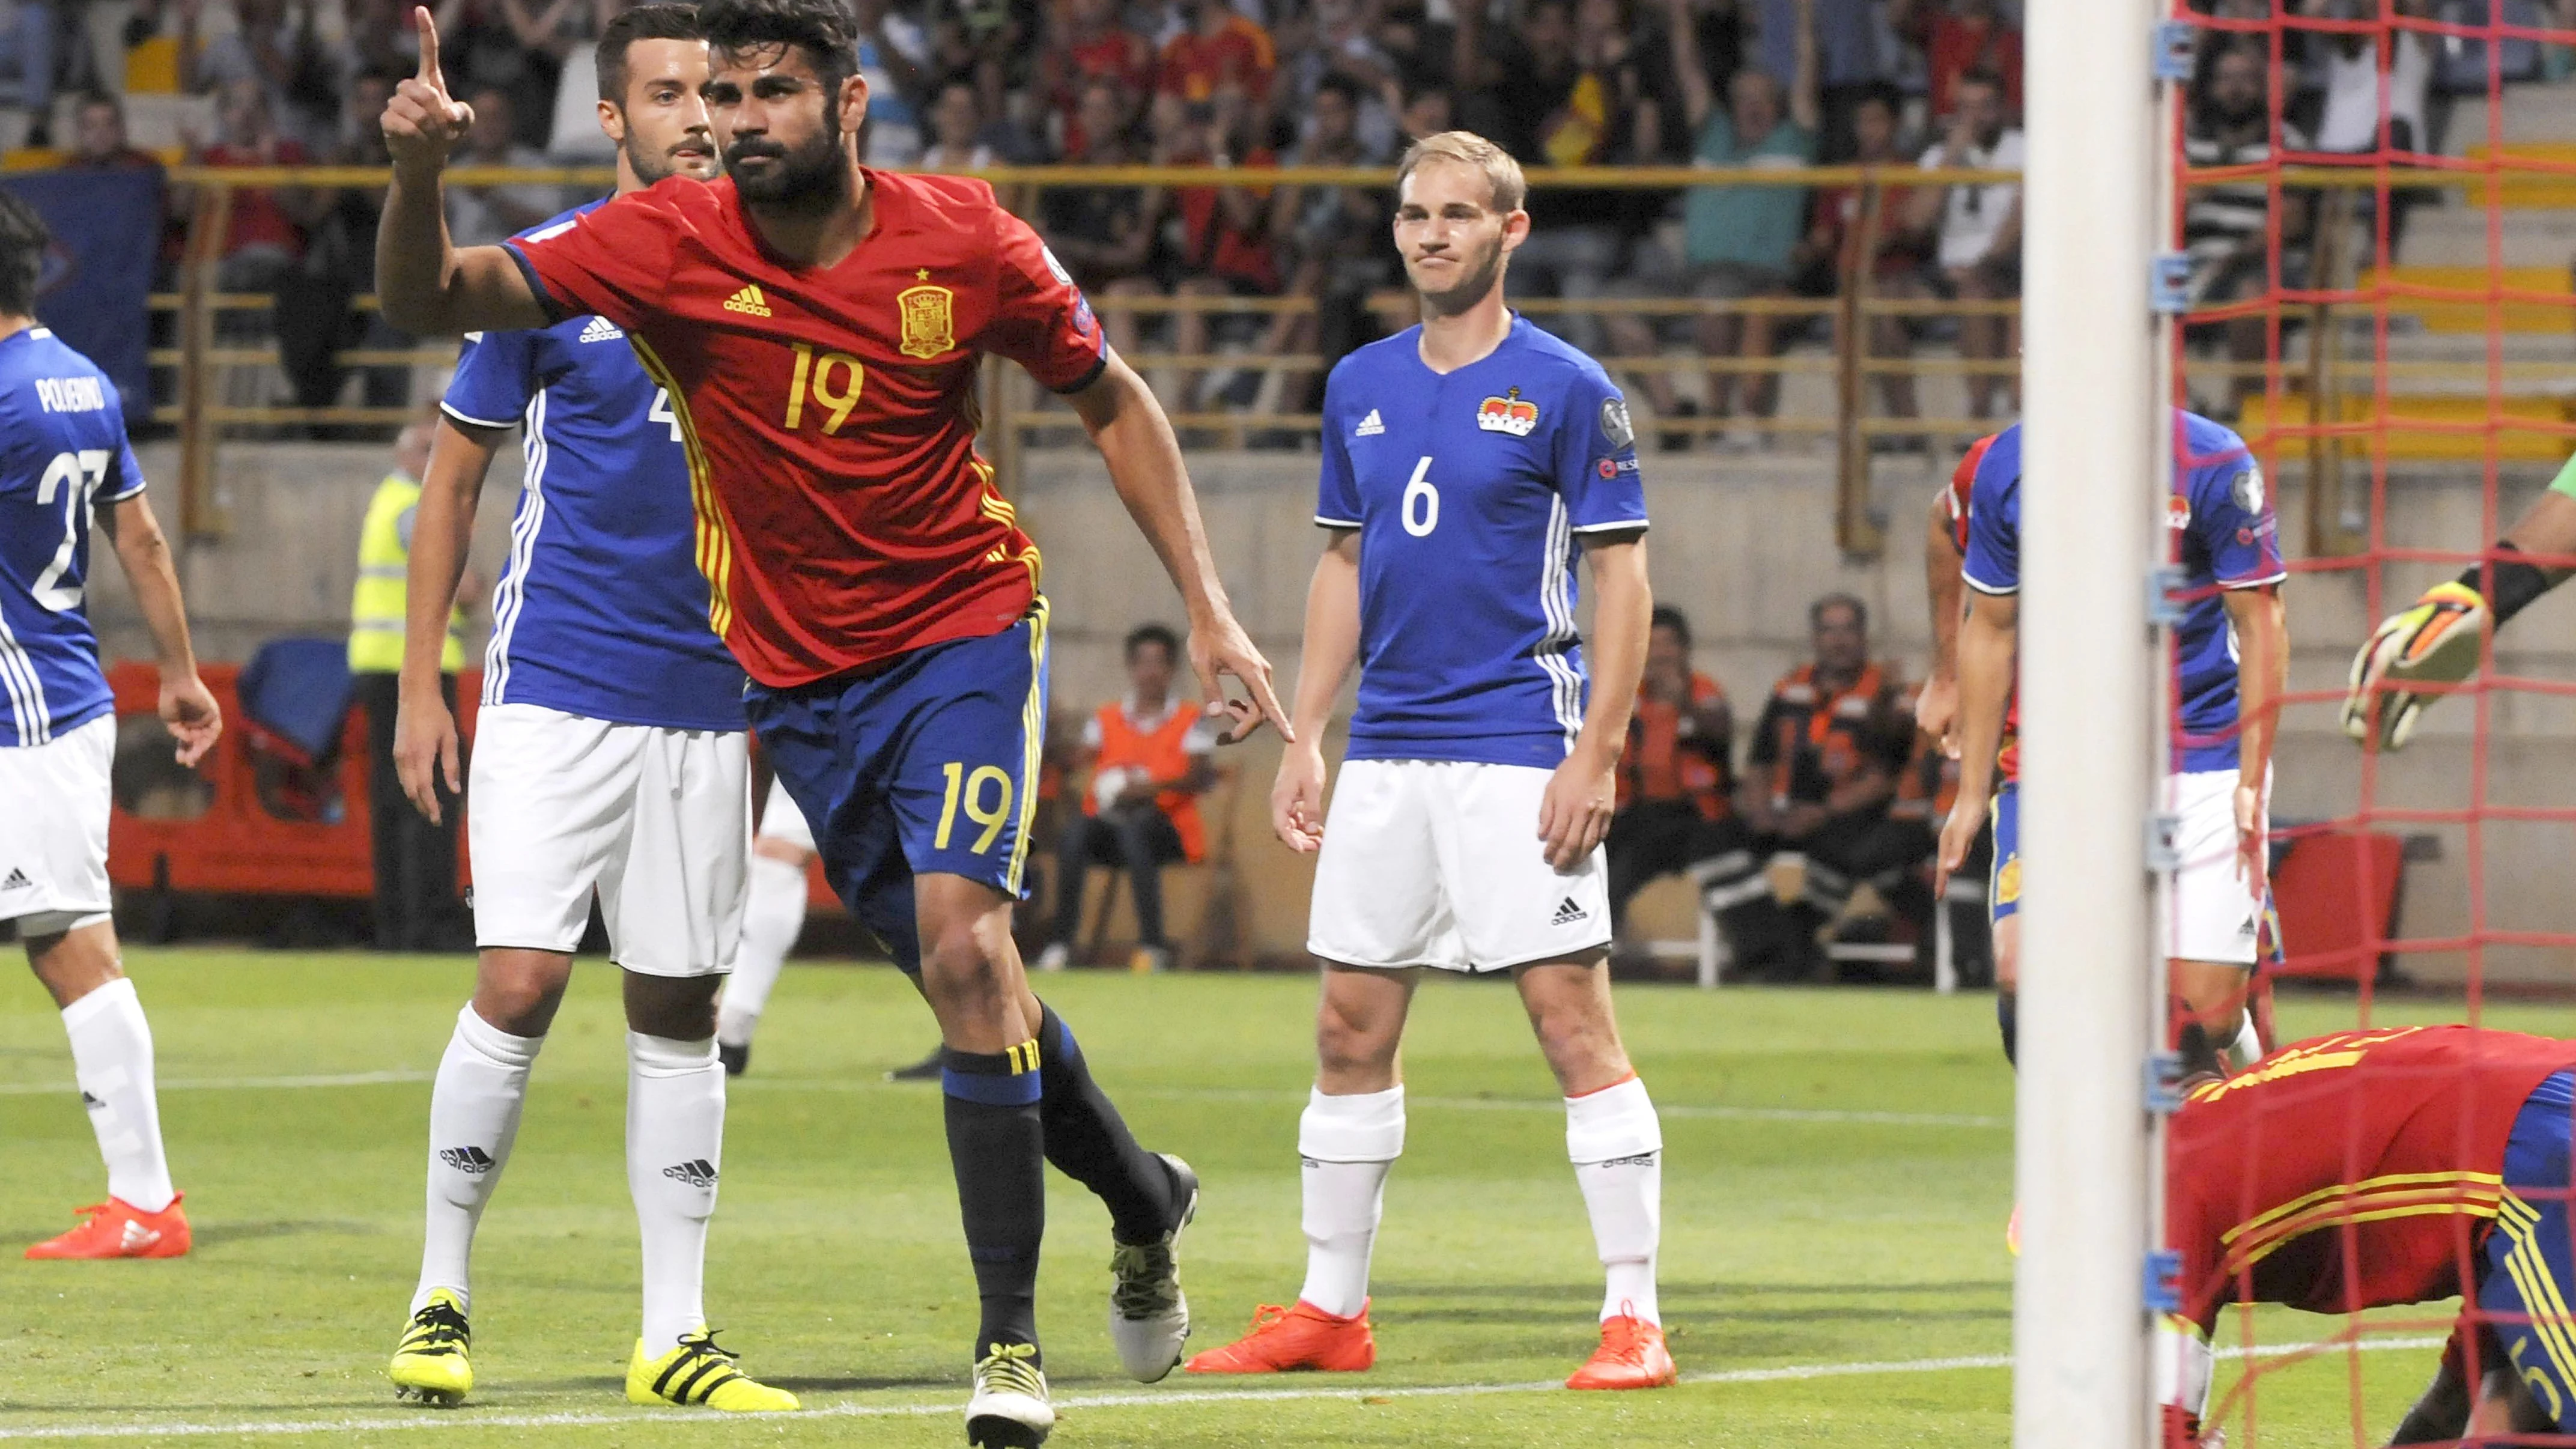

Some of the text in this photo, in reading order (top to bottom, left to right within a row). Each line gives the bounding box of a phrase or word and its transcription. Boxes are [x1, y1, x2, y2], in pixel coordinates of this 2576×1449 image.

[579, 330, 623, 343] adidas
[723, 300, 772, 317] adidas
[648, 387, 682, 442] 4
[785, 342, 864, 435] 19
[32, 449, 110, 612] 27
[1402, 456, 1439, 537] 6
[934, 762, 1013, 855] 19
